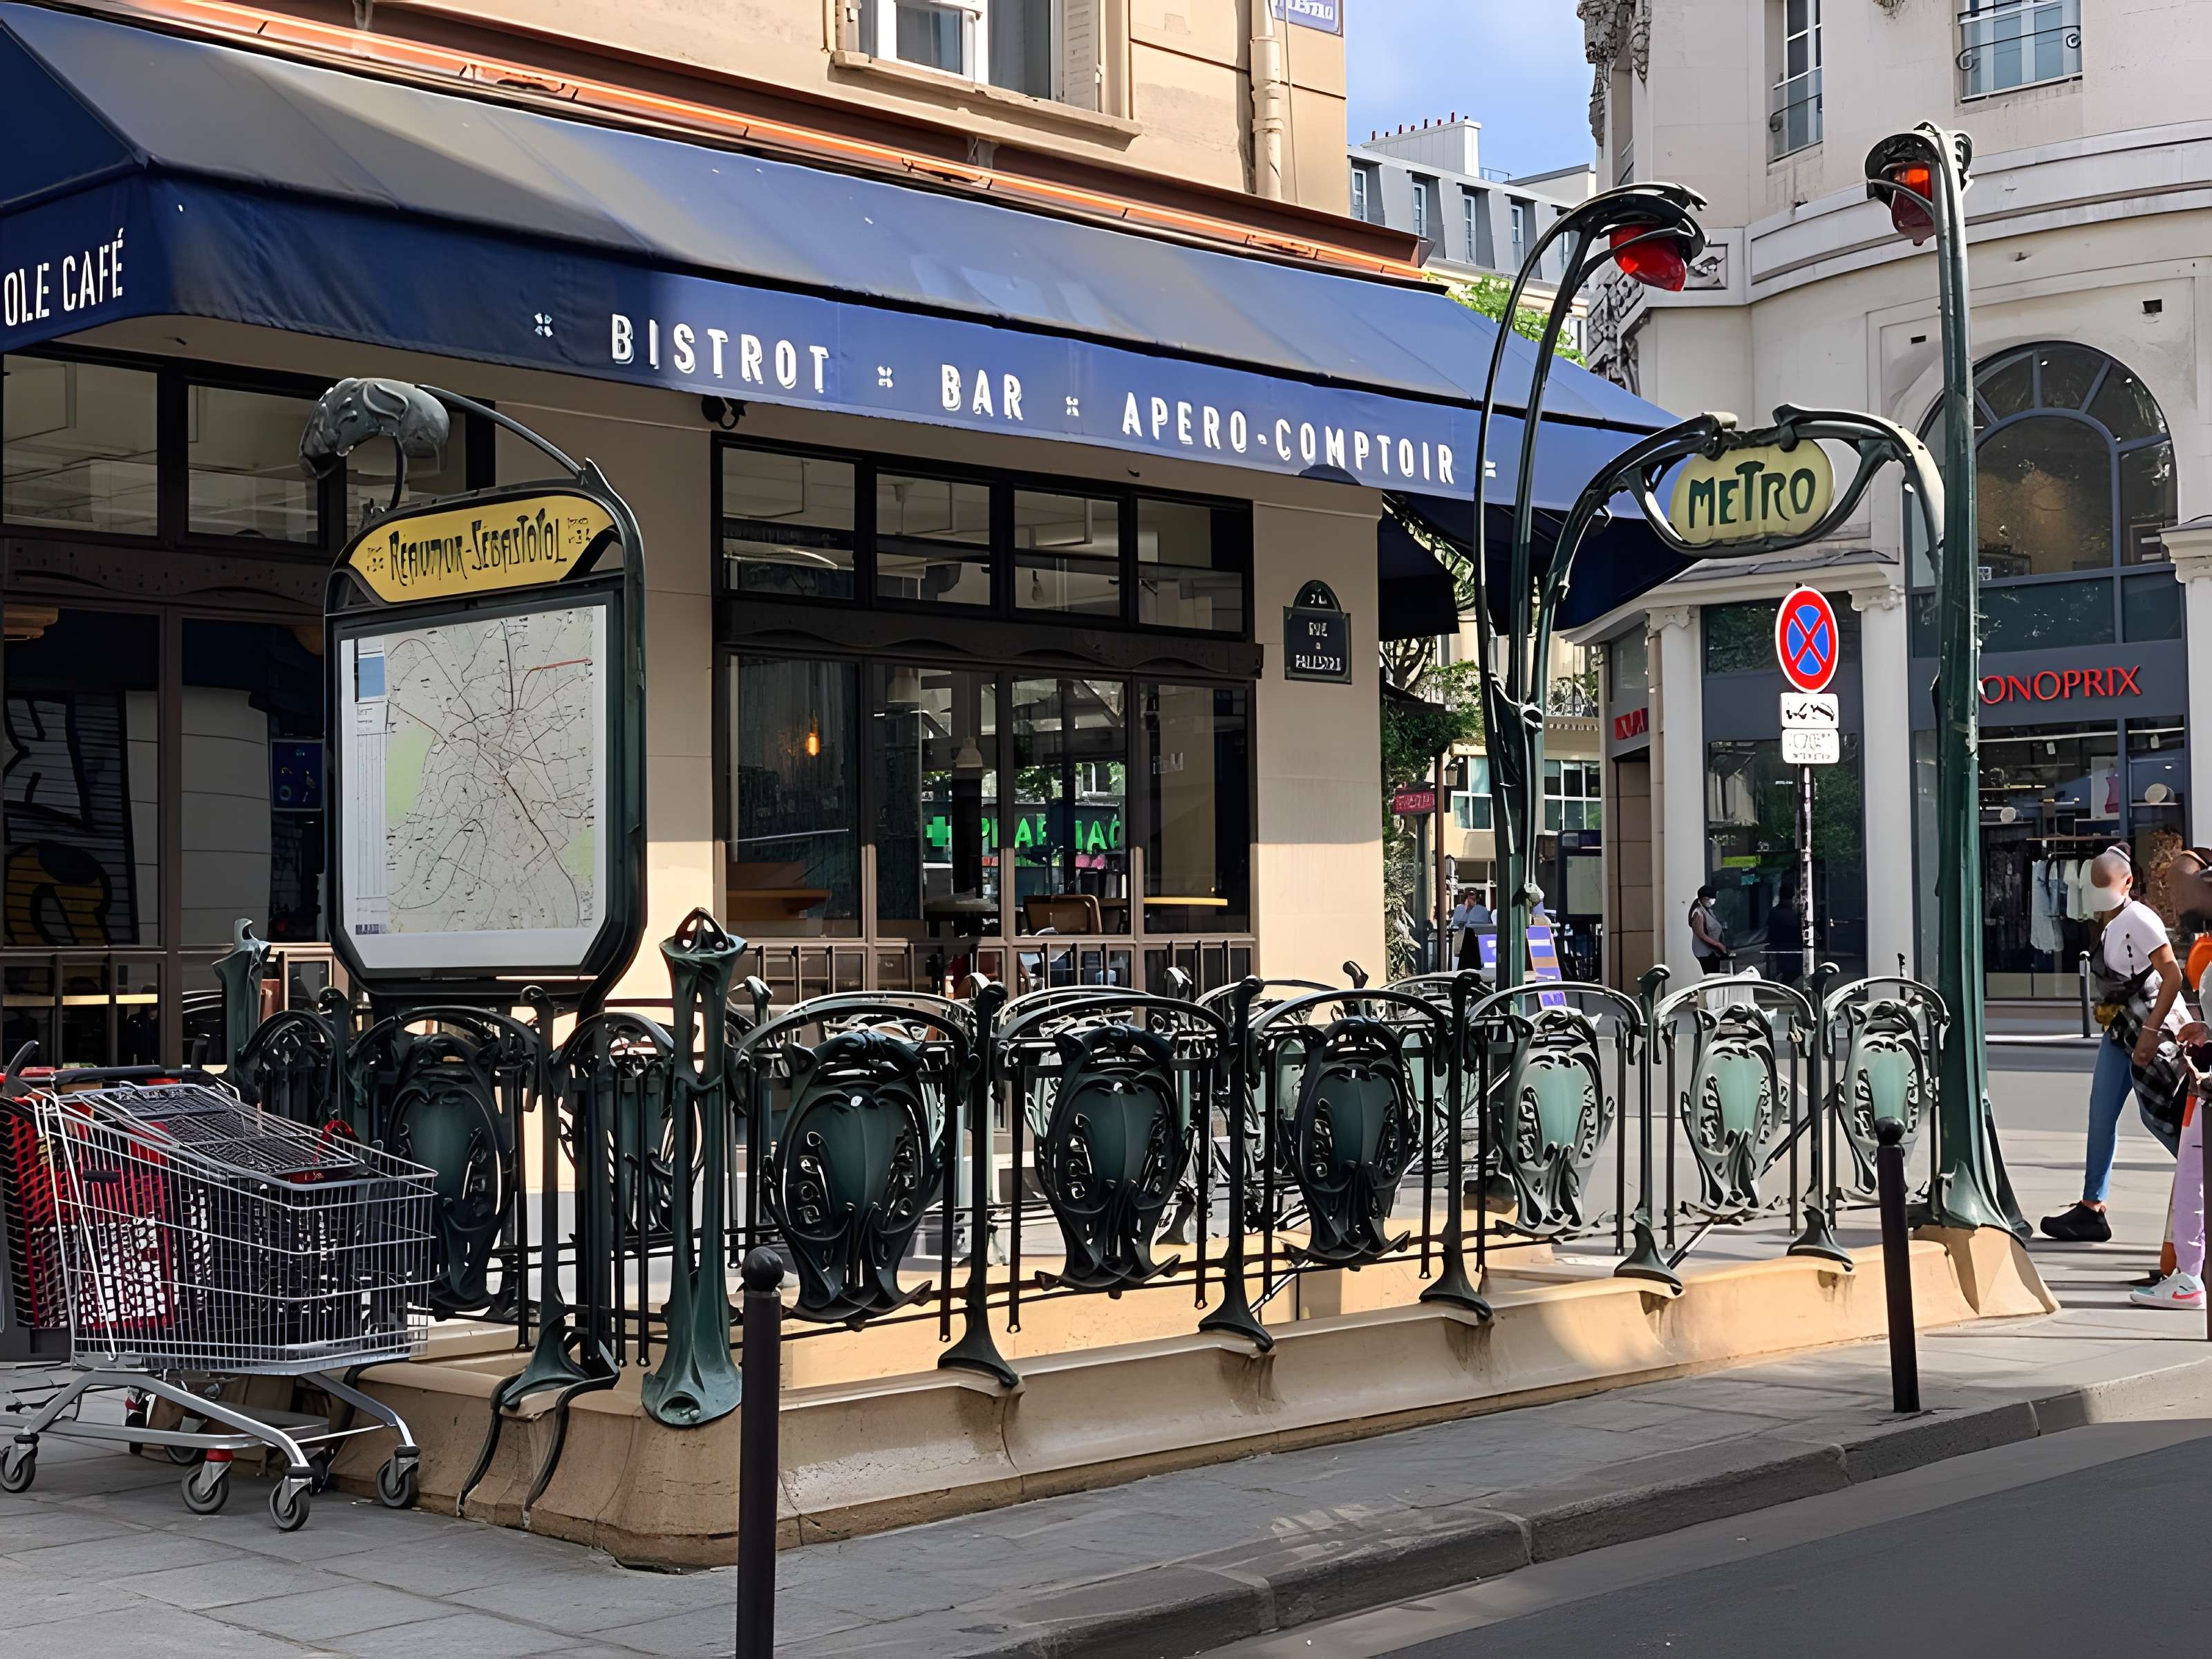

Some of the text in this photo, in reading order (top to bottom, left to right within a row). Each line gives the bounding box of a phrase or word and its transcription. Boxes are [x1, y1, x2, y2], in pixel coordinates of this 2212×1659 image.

[62, 227, 124, 312] CAFÉ
[611, 312, 830, 394] BISTROT
[941, 364, 1024, 421] BAR
[1688, 460, 1817, 529] METRO
[1979, 664, 2142, 706] ONOPRIX
